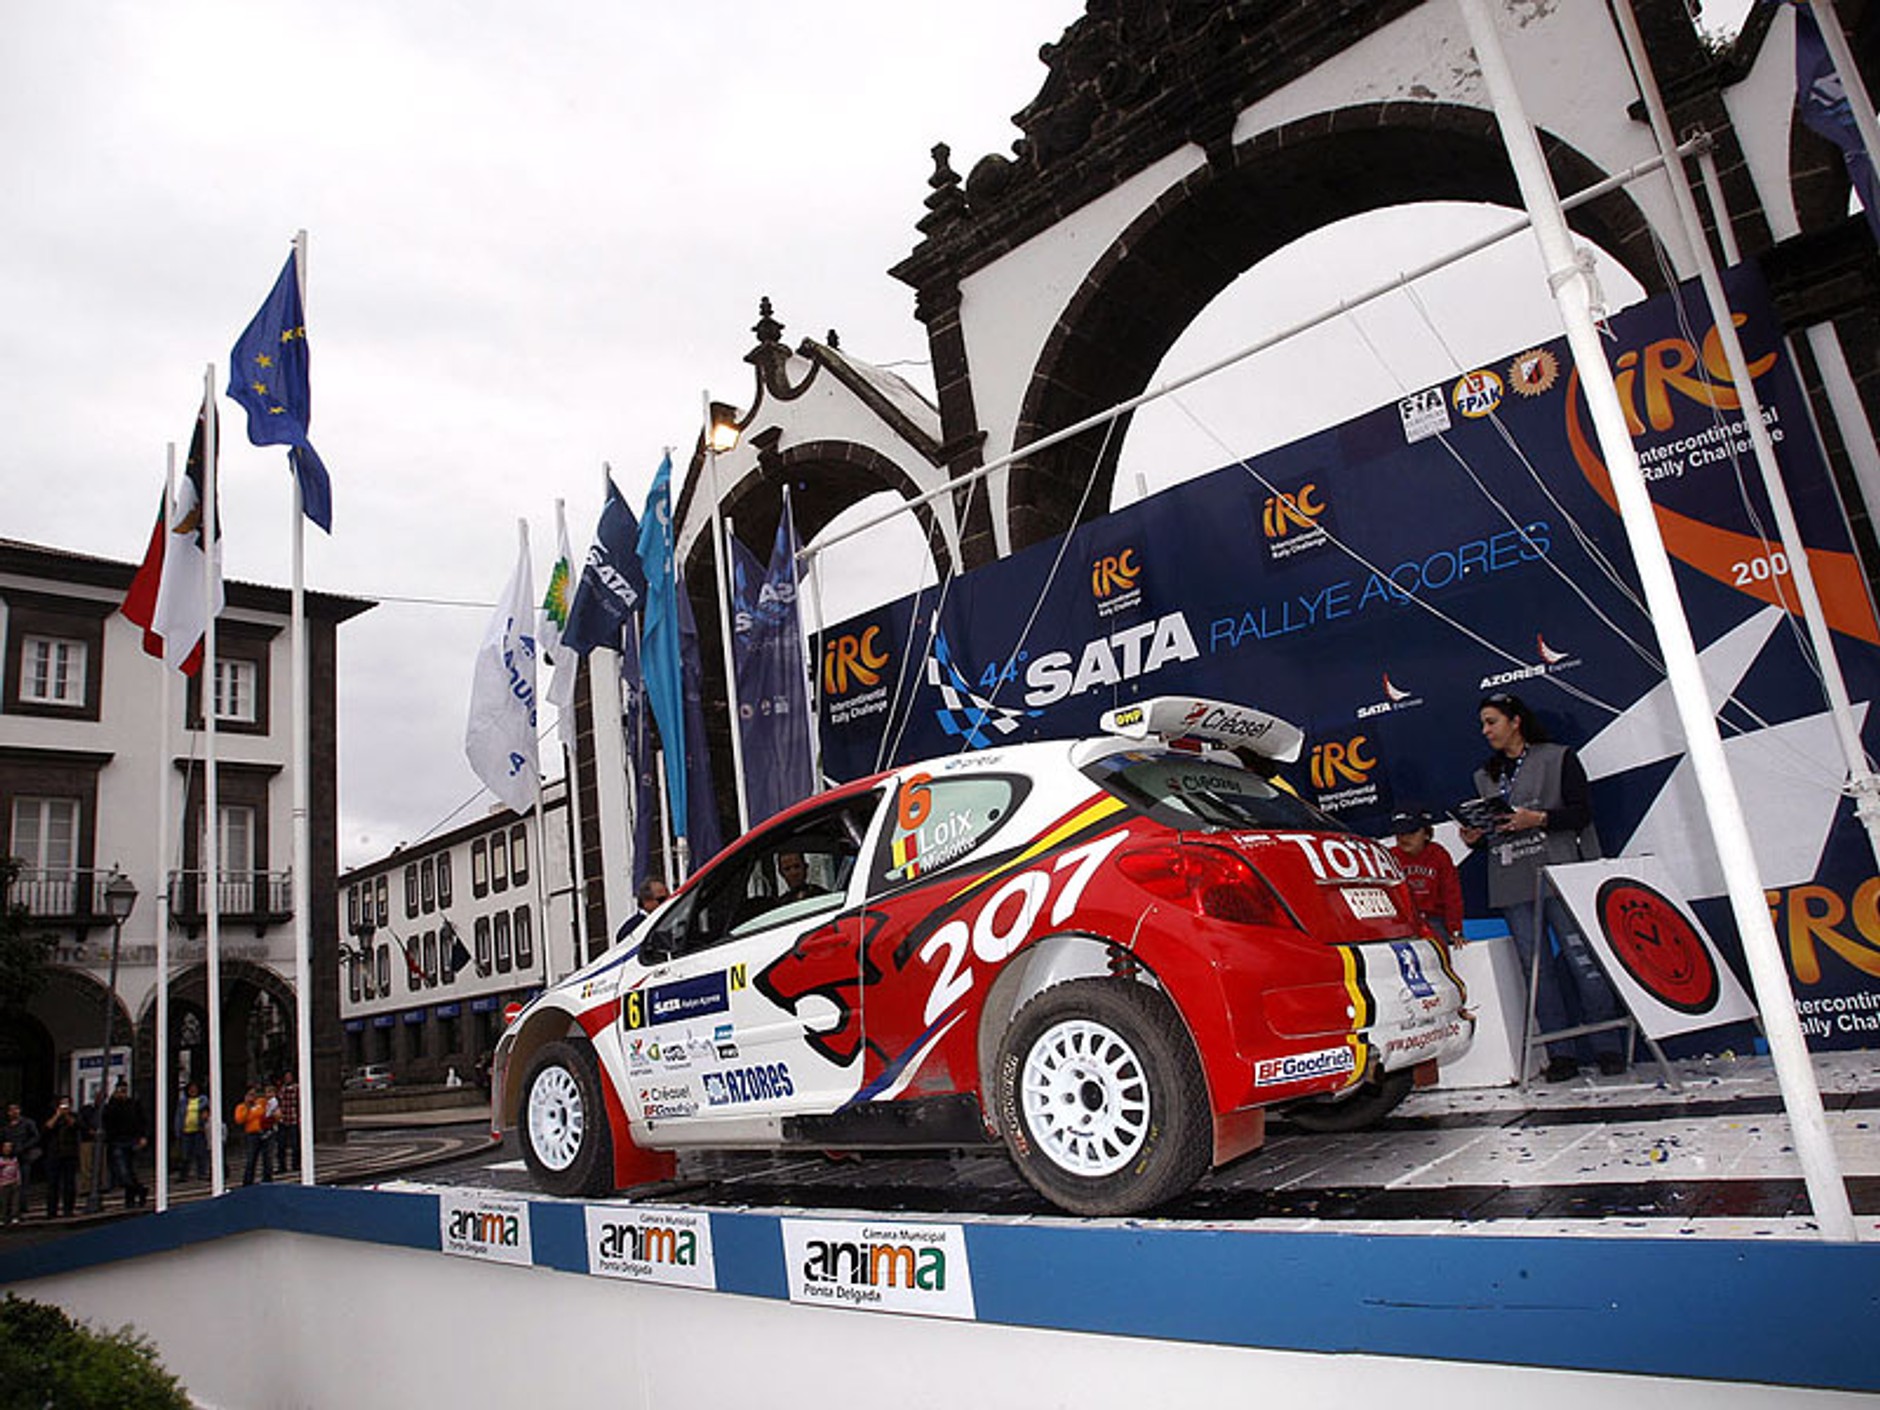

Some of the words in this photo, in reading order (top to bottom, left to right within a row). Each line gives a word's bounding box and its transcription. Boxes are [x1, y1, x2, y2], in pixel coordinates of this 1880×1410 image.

[1640, 458, 1685, 482] Rally
[1731, 551, 1789, 587] 200
[1025, 611, 1200, 707] SATA
[1210, 581, 1352, 653] RALLYE
[1359, 521, 1551, 611] AÇORES
[1480, 664, 1545, 689] AZORES
[1115, 709, 1143, 727] OMP
[1357, 702, 1391, 718] SATA
[899, 772, 932, 831] 6
[919, 809, 972, 853] Loix
[919, 829, 1130, 1028] 207
[731, 963, 746, 990] N
[627, 992, 641, 1029] 6
[1801, 1017, 1832, 1037] ally
[1259, 1048, 1354, 1080] BFGoodrich
[449, 1209, 519, 1247] anima
[600, 1223, 697, 1266] anima
[862, 1228, 897, 1241] Câmara
[899, 1230, 946, 1244] Municipal
[803, 1240, 946, 1291] anima
[803, 1284, 834, 1298] Ponta
[836, 1286, 882, 1305] Delgada
